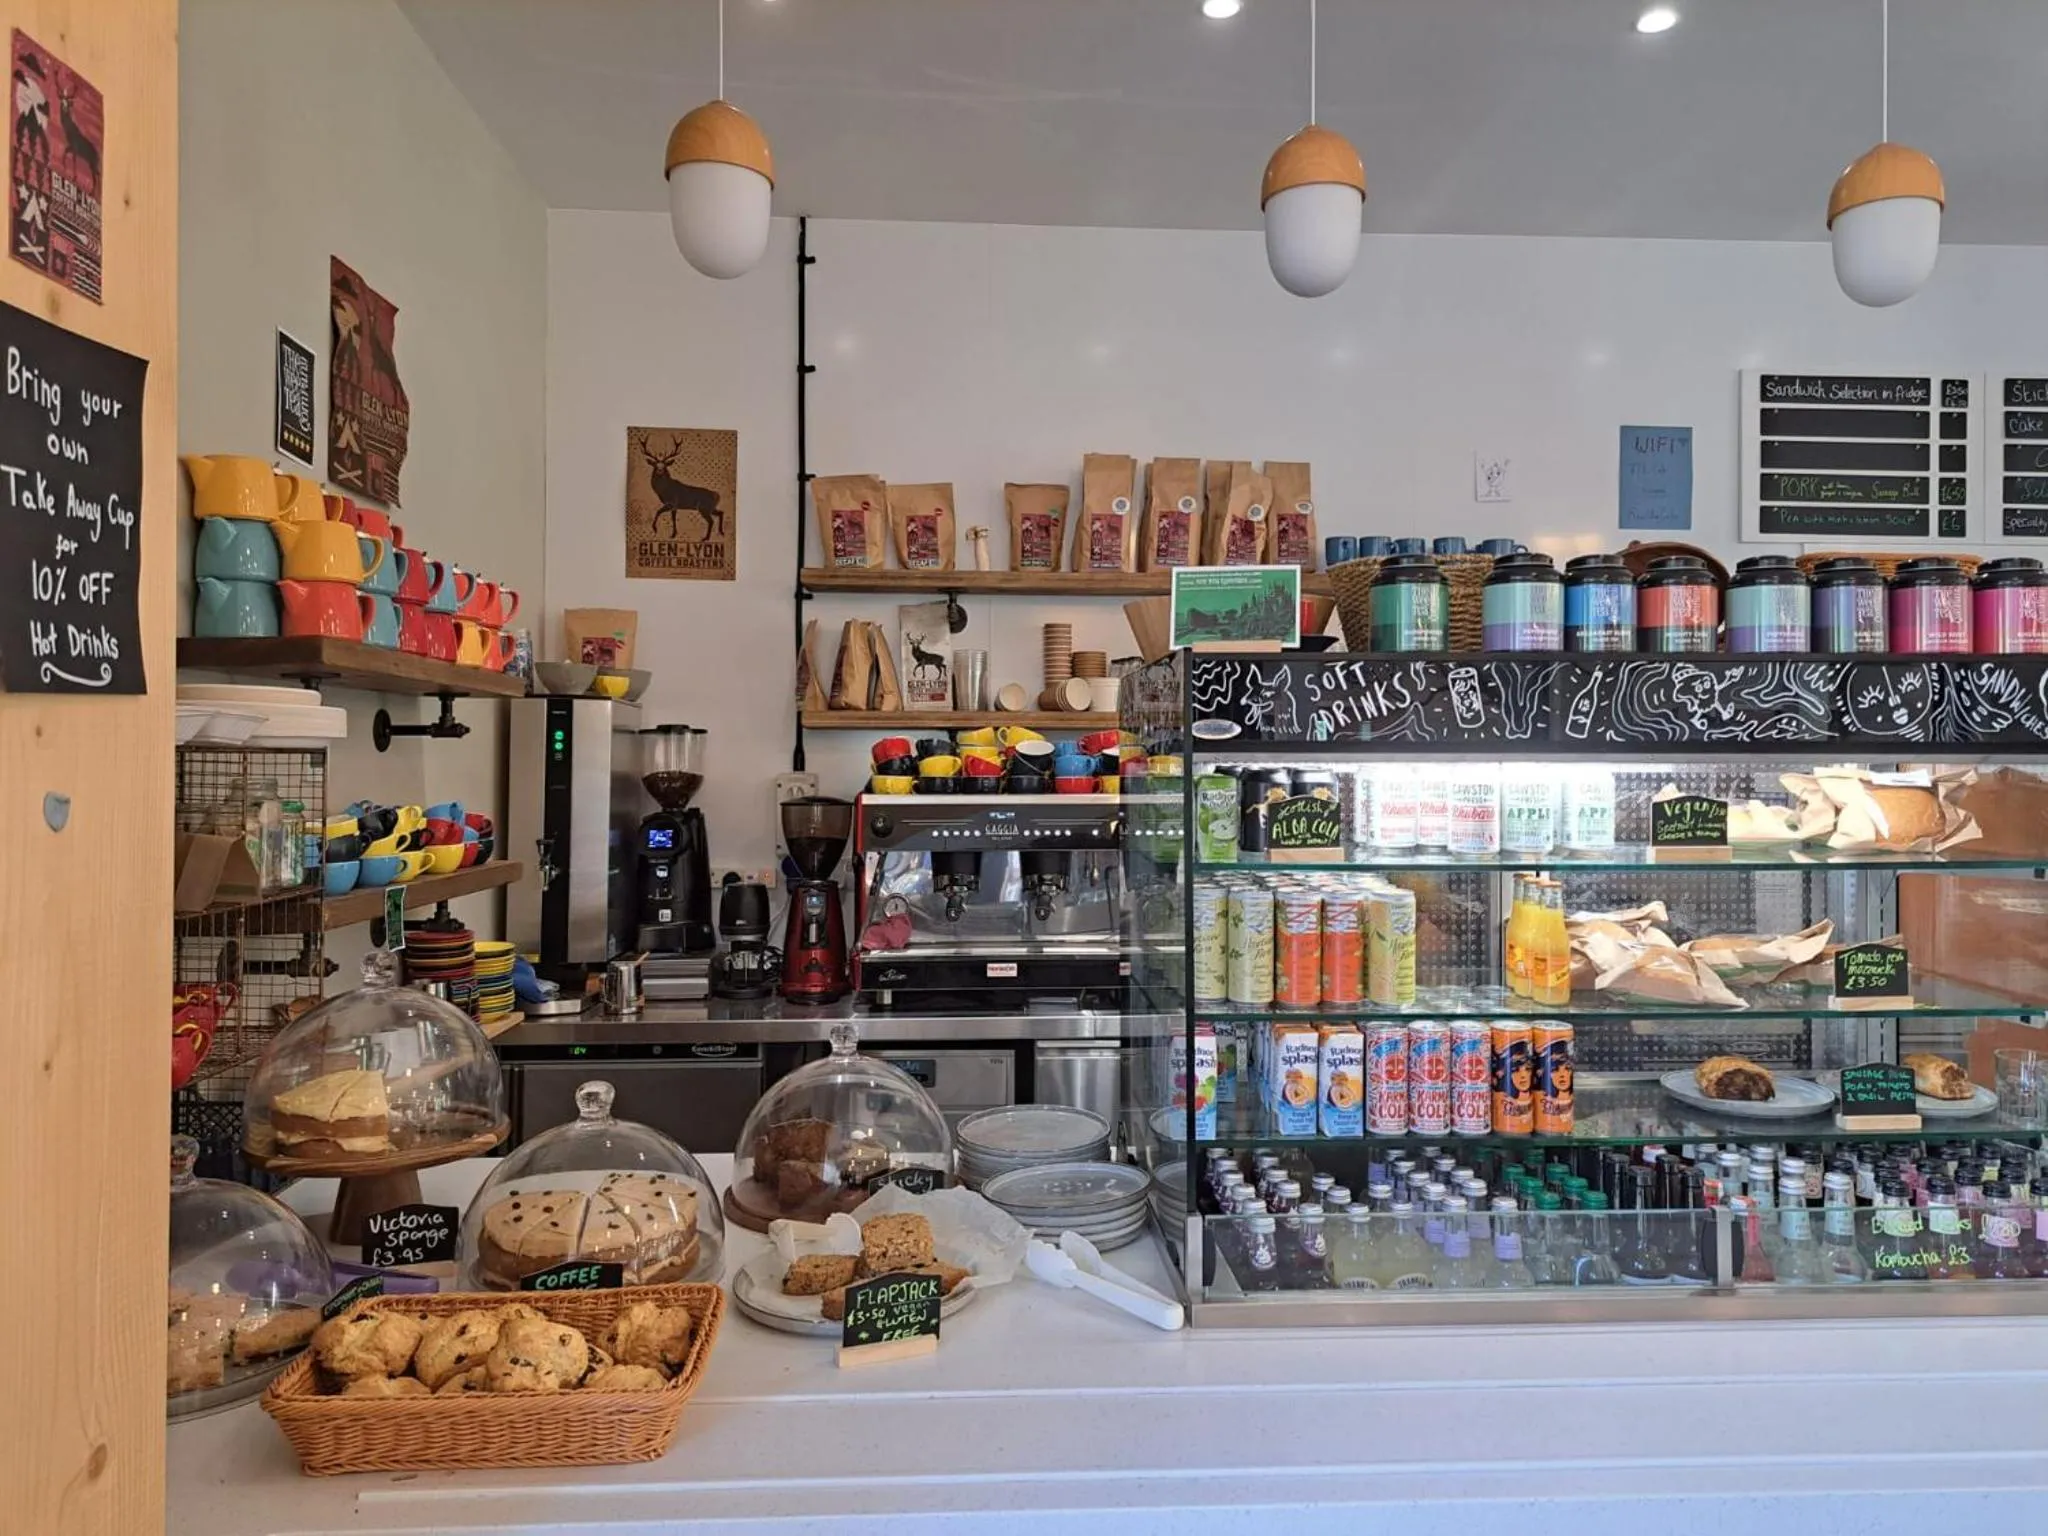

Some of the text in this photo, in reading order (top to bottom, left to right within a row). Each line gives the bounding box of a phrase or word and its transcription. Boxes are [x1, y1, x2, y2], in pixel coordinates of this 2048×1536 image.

[7, 346, 122, 427] Bring your
[1766, 378, 1825, 399] Sandwich
[1829, 383, 1879, 400] Selection
[2009, 417, 2044, 434] Cake
[48, 434, 89, 465] own
[1, 464, 135, 549] Take Away Cup
[55, 534, 78, 561] for
[639, 542, 725, 558] GLEN LYON
[638, 557, 725, 569] COFFEE ROASTERS
[32, 560, 115, 606] 10% OFF
[30, 620, 119, 660] Hot Drinks
[1304, 661, 1368, 702] SOFT
[1319, 672, 1412, 730] DRINKS
[1578, 807, 1607, 819] APP
[1664, 802, 1710, 822] Vegan
[1272, 816, 1340, 841] ALBA COLA
[1844, 975, 1888, 990] £3.50
[1379, 1090, 1409, 1102] KARM
[1379, 1103, 1408, 1119] COL
[369, 1211, 445, 1236] Victoria
[371, 1247, 425, 1267] £3.95
[1874, 1245, 1942, 1268] Kombucha
[535, 1264, 603, 1290] COFFEE
[856, 1280, 938, 1309] FLAPJACK
[847, 1307, 886, 1328] £3.50
[881, 1324, 921, 1342] FREE
